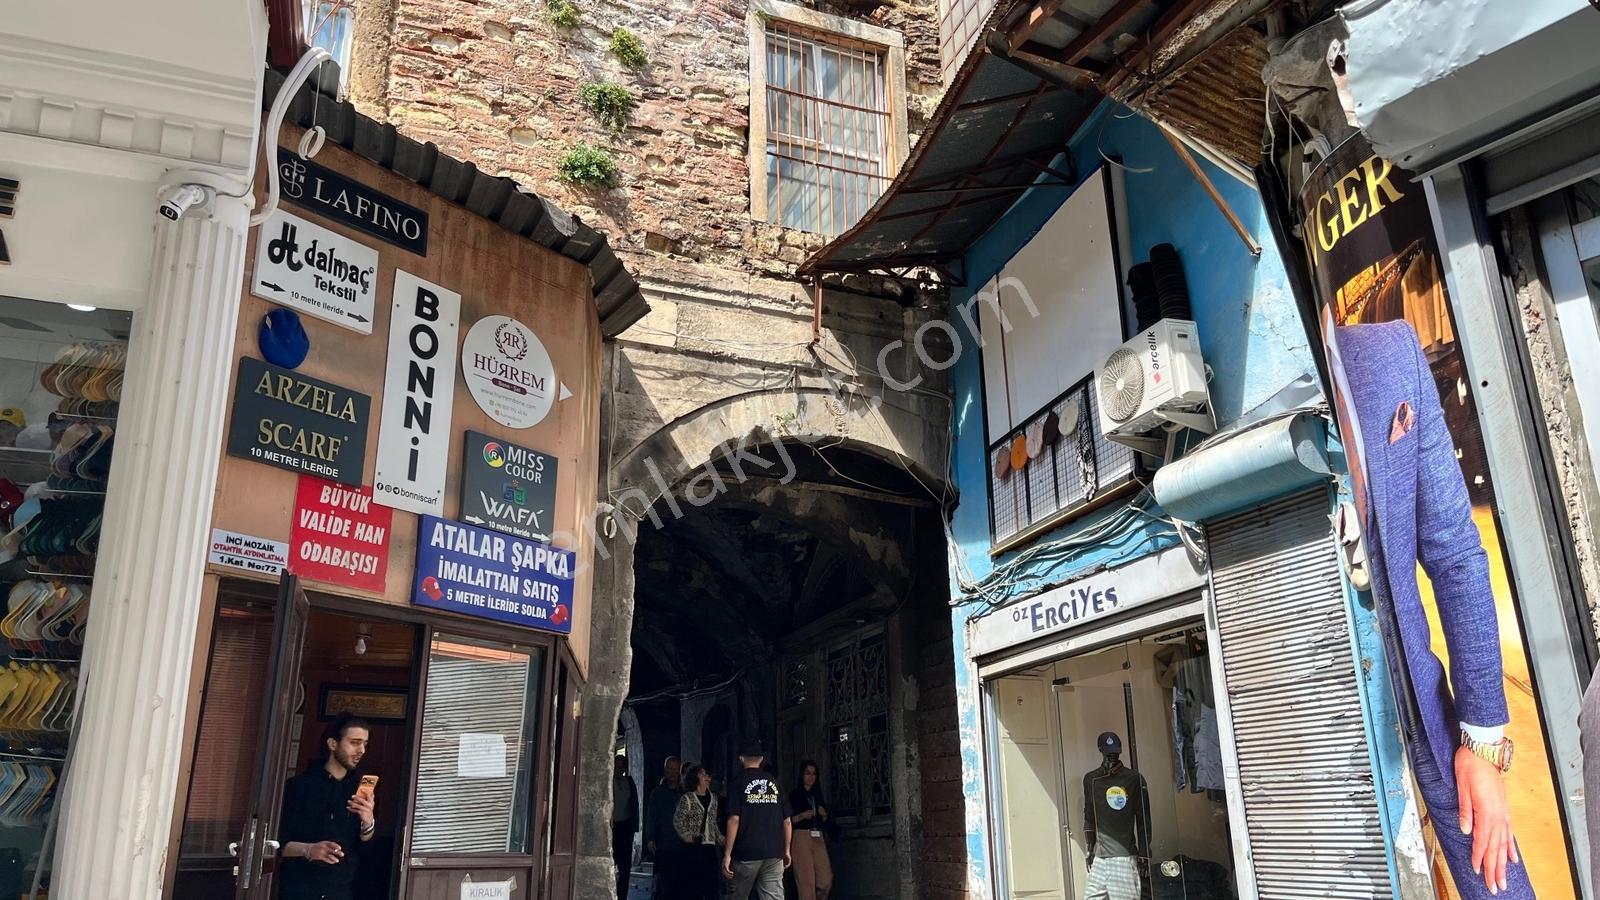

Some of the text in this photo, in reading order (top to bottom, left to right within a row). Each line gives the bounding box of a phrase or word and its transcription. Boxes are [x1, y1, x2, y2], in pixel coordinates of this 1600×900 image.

[313, 177, 421, 241] LAFINO
[304, 239, 371, 295] dalmaç
[290, 290, 345, 316] 10 metre ileride
[313, 273, 357, 303] Tekstil
[1147, 330, 1160, 370] arçelik
[254, 370, 358, 424] ARZELA
[257, 418, 343, 463] SCARF
[250, 447, 340, 478] 10 METRE İLERİDE
[504, 463, 542, 484] COLOR
[507, 446, 545, 473] MISS
[319, 483, 372, 515] BÜYÜK
[400, 487, 438, 505] bonniscarf
[300, 508, 386, 546] VALİDE HAN
[488, 520, 531, 537] 10 metre ileride
[213, 542, 285, 563] OTANTİK AYDINLATMA
[225, 533, 275, 553] İNCİ MOZAİK
[300, 540, 379, 576] ODABAŞISI
[430, 522, 569, 578] ATALAR ŞAPKA
[219, 555, 277, 573] 1.Kat No:72
[437, 554, 560, 608] İMALATTAN SATIŞ
[446, 588, 547, 620] 5 METRE İLERİDE SOLDA
[1012, 606, 1028, 622] ÖZ
